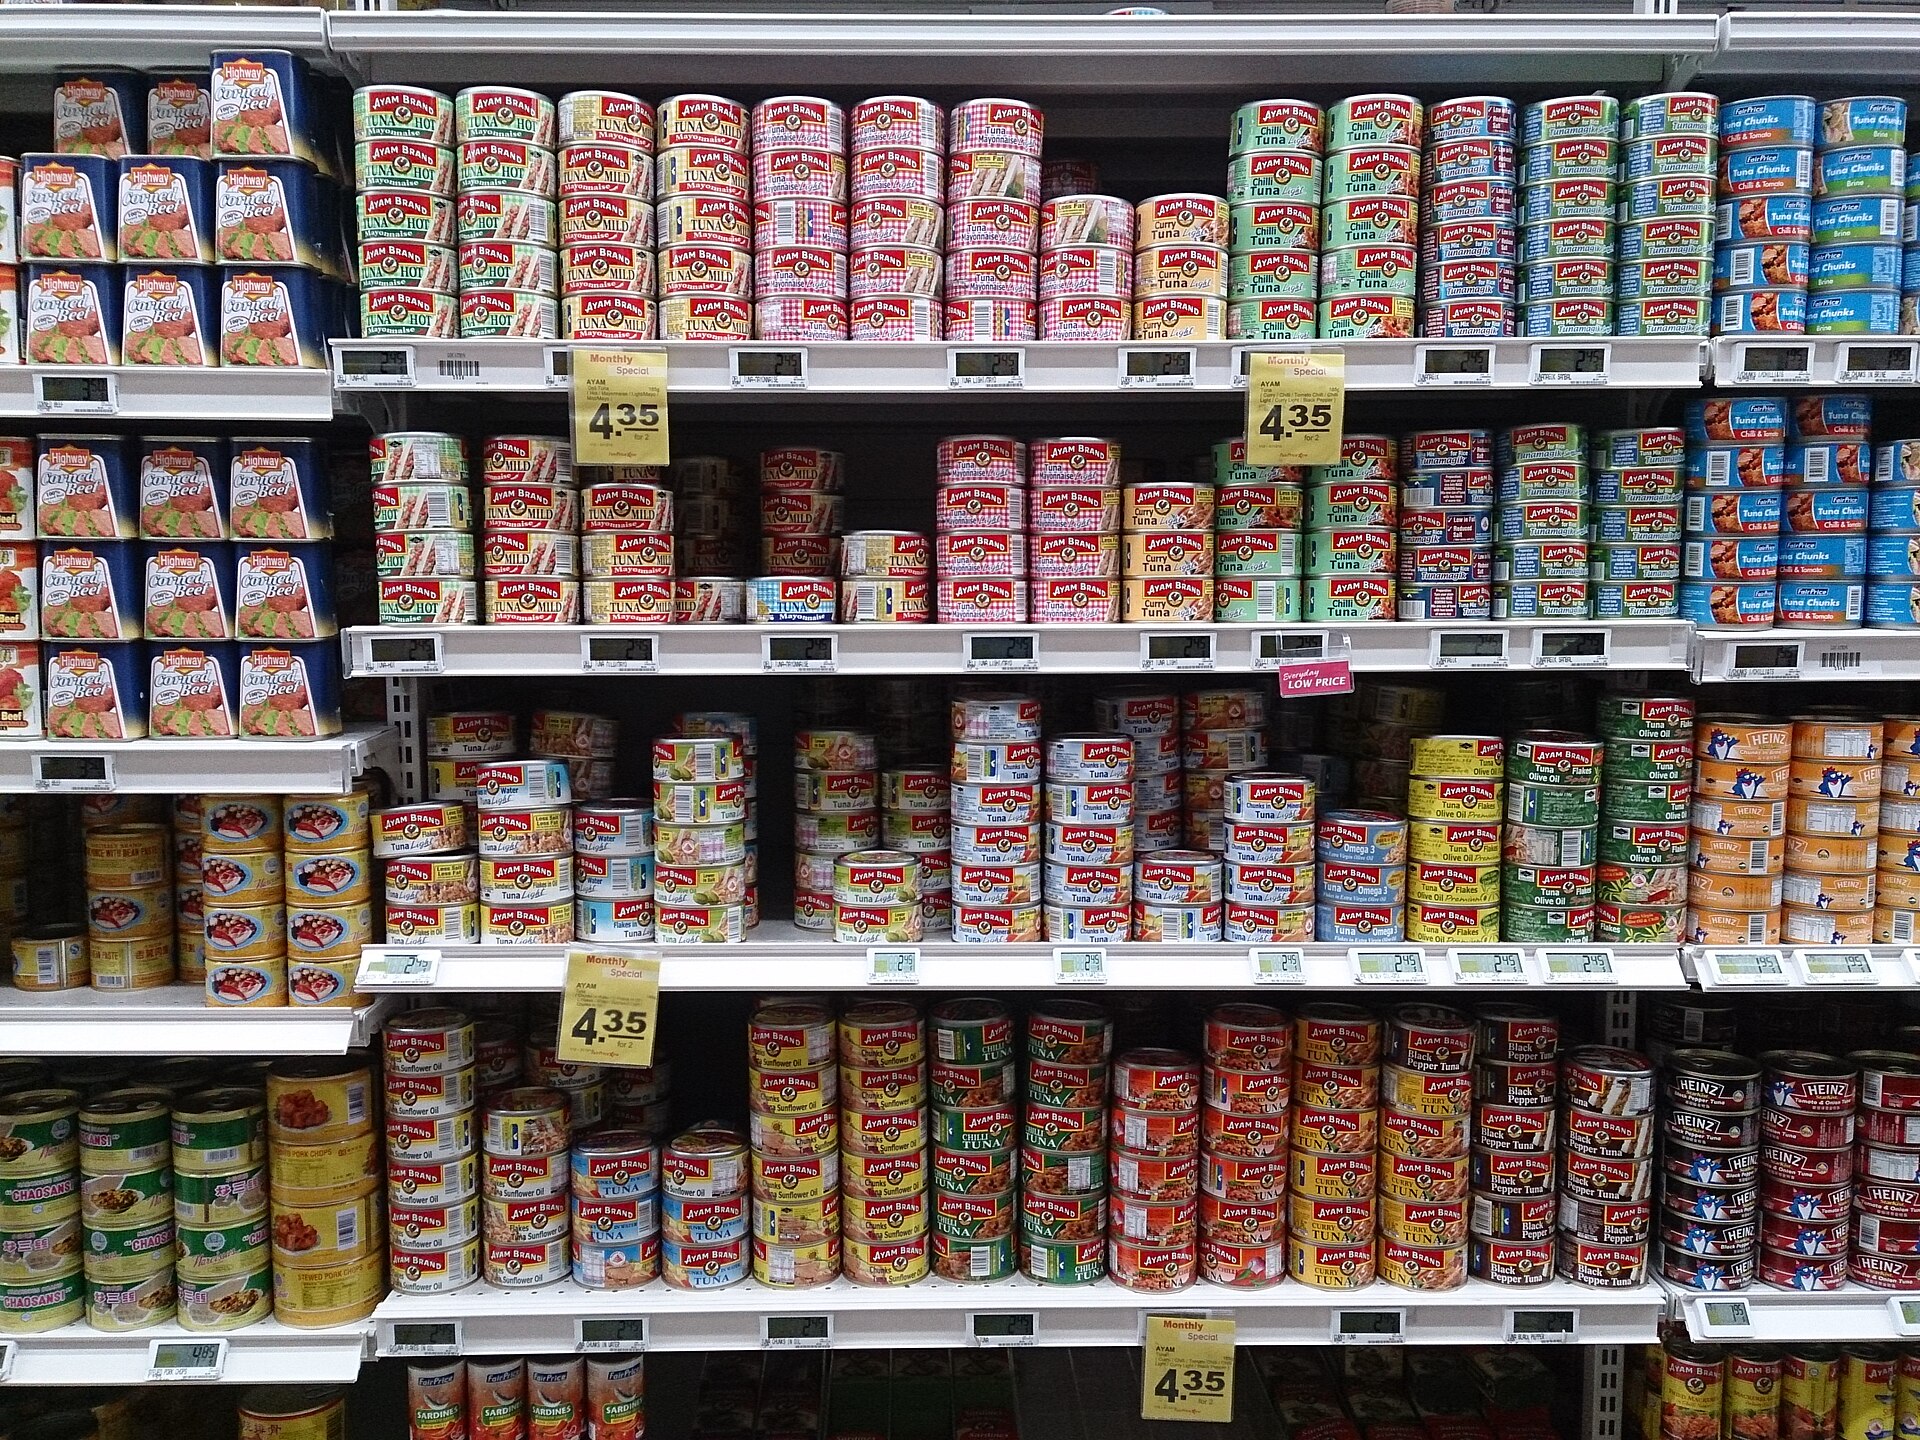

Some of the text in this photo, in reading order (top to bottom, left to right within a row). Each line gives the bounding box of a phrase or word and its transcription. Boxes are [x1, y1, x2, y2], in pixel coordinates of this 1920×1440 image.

[226, 66, 261, 81] Highway
[216, 85, 272, 101] Corned
[239, 98, 275, 109] Beef
[373, 95, 434, 114] AYAM BRAND
[366, 117, 436, 130] TUNA HOT
[366, 129, 420, 137] Mayonnaise
[774, 153, 829, 170] AYAM BRAND
[1747, 154, 1778, 163] FairPrice
[1841, 153, 1871, 162] FairPrice
[1732, 164, 1790, 177] Tuna Chunks
[1826, 163, 1885, 176] Tuna Chunks
[36, 170, 72, 185] Highway
[563, 171, 630, 182] TUNA MILD
[1252, 178, 1273, 186] Chilli
[563, 183, 610, 192] Mayonnaise
[764, 183, 798, 192] Mayonnaise
[1738, 181, 1752, 189] Chilli
[1762, 179, 1784, 188] Tomato
[1846, 179, 1864, 187] Brine
[28, 190, 82, 204] Corned
[1251, 187, 1280, 196] Tuna
[51, 202, 86, 214] Beef
[1443, 226, 1492, 242] AYAM BRAND
[1443, 248, 1490, 258] Tunamagik
[1162, 250, 1216, 268] AYAM BRAND
[1159, 271, 1180, 280] Curry
[1158, 278, 1211, 289] Tuna Light
[590, 354, 632, 365] Monthly
[1268, 356, 1310, 366] Monthly
[617, 367, 648, 375] Special
[1294, 368, 1326, 376] Special
[590, 403, 659, 440] 4.35
[1260, 405, 1332, 441] 4.35
[160, 556, 197, 569] Highway
[150, 572, 208, 587] Corned
[175, 584, 210, 597] Beef
[786, 583, 833, 597] AYAM BRAND
[777, 602, 807, 612] TUNA
[1807, 598, 1840, 606] Chunks
[779, 613, 825, 621] Mayonnaise
[1283, 669, 1320, 681] Everyday
[1288, 677, 1346, 689] LOW PRICE
[1, 711, 22, 721] Beef
[1752, 734, 1786, 745] HEINZ
[1535, 765, 1592, 775] Tuna Flakes
[1529, 773, 1560, 783] Olive Oil
[1436, 810, 1466, 818] Olive Oil
[522, 889, 546, 900] Light
[1324, 883, 1388, 896] Tuna Omega 3
[586, 955, 628, 967] Monthly
[1395, 954, 1416, 972] 245
[1495, 955, 1515, 972] 245
[1583, 955, 1604, 973] 245
[611, 969, 642, 978] Special
[572, 1008, 646, 1045] 4.35
[1680, 1080, 1719, 1096] HEINZ
[1808, 1084, 1845, 1096] HEINZ
[1487, 1115, 1542, 1128] AYAM BRAND
[962, 1133, 988, 1142] CHILLI
[1481, 1127, 1504, 1139] Black
[962, 1138, 1000, 1149] TUNA
[1481, 1136, 1534, 1150] Pepper Tuna
[511, 1202, 565, 1219] AYAM BRAND
[510, 1225, 530, 1233] Flakes
[528, 1227, 556, 1240] Sunflower
[557, 1224, 565, 1233] Oil
[298, 1272, 322, 1281] STEWED
[325, 1270, 342, 1279] PORK
[1314, 1267, 1338, 1276] CURRY
[694, 1274, 730, 1286] TUNA
[1314, 1275, 1352, 1286] TUNA
[1163, 1320, 1203, 1331] Monthly
[1188, 1333, 1218, 1341] Special
[419, 1374, 454, 1385] FairPrice
[1155, 1369, 1225, 1403] 4.35
[417, 1406, 459, 1419] SARDINES
